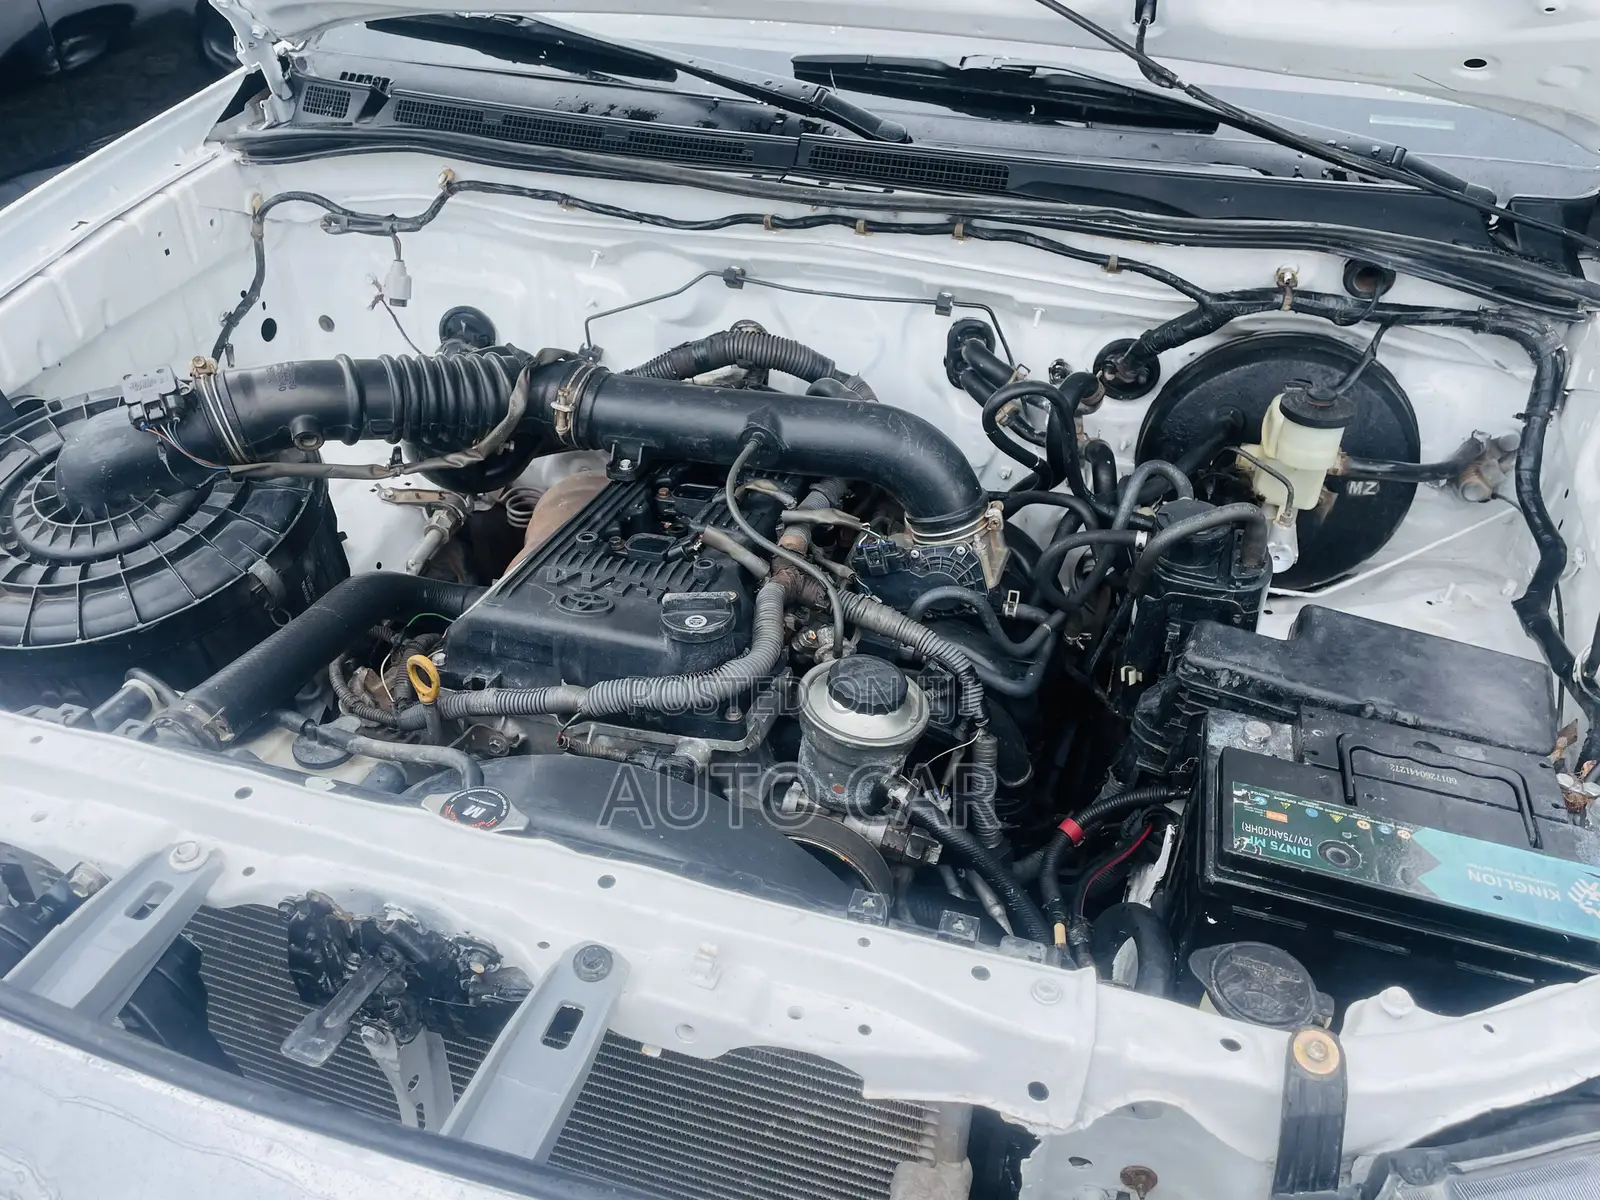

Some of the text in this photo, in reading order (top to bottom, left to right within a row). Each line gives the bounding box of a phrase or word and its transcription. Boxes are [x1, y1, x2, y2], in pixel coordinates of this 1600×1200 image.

[1348, 481, 1378, 495] MZ
[1270, 841, 1311, 859] DIN75
[1466, 868, 1562, 901] KINGLION
